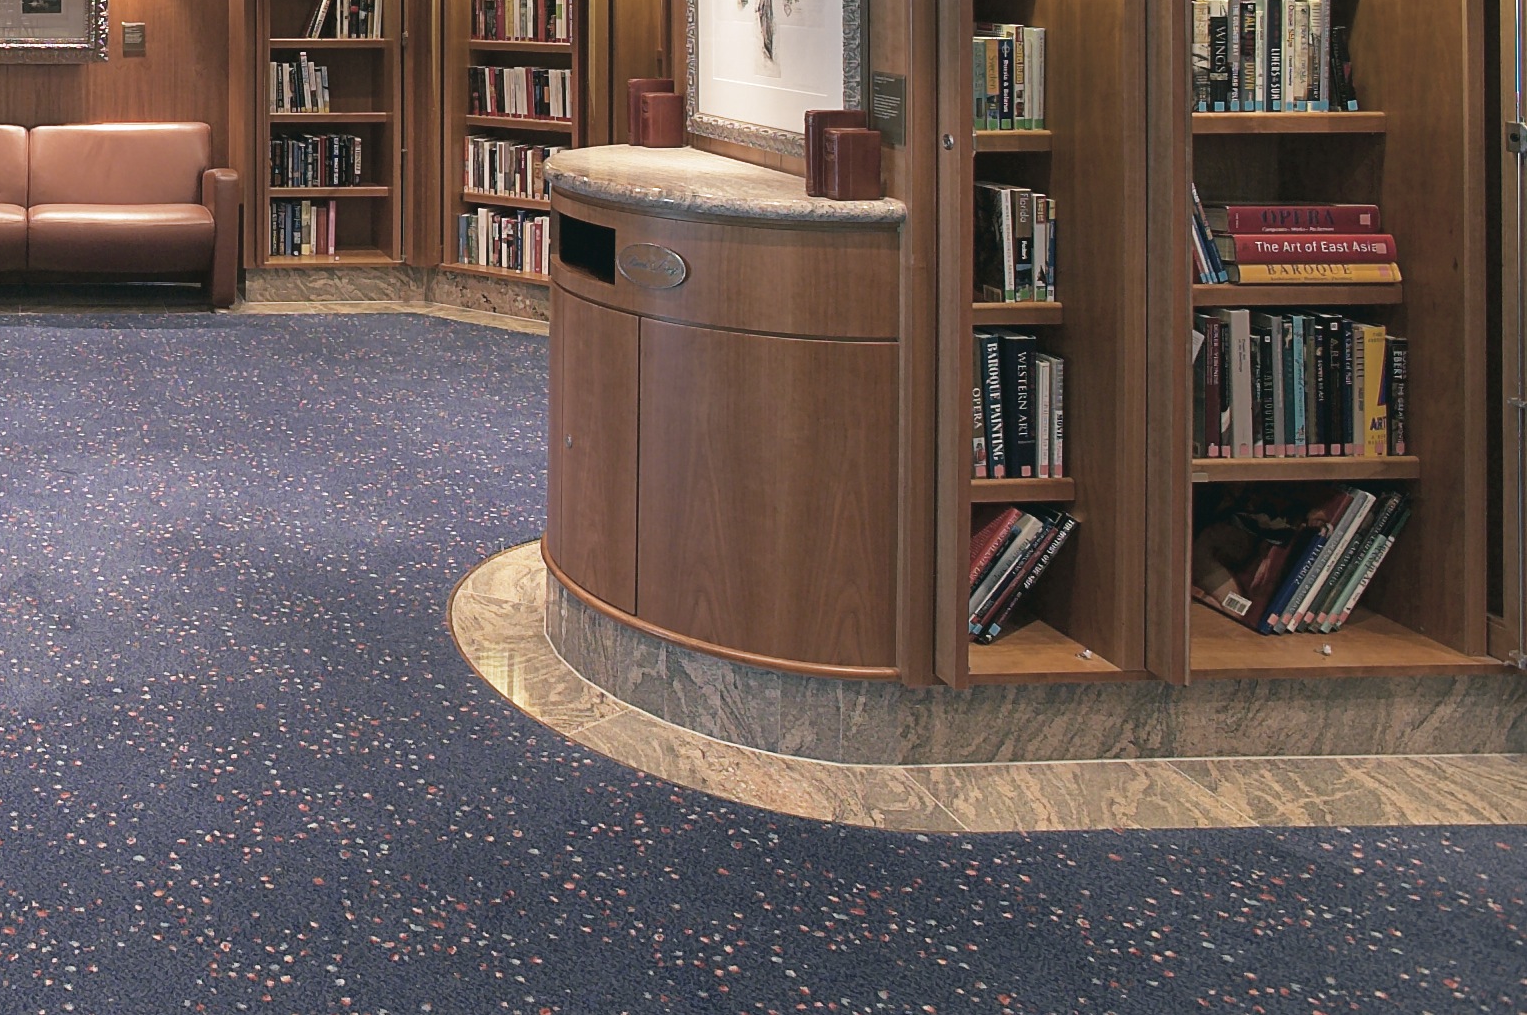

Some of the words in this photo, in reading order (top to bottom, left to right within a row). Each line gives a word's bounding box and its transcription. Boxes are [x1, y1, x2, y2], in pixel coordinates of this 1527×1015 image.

[1215, 26, 1226, 73] WINGS
[1270, 48, 1281, 76] LINERS
[988, 55, 998, 90] Sweden
[1244, 62, 1255, 90] DOWN
[1270, 83, 1281, 100] SUN
[1019, 193, 1029, 223] Florida
[1260, 208, 1336, 225] OPERA
[1255, 241, 1279, 253] The
[1282, 241, 1302, 253] Art
[1305, 241, 1317, 253] of
[1321, 241, 1349, 253] East
[1352, 241, 1377, 253] Asia
[1267, 264, 1353, 276] BAROQUE
[986, 342, 1001, 400] BAROQUE
[1393, 350, 1403, 379] EBERT
[1018, 351, 1028, 410] WESTERN
[972, 387, 983, 430] OPERA
[990, 403, 1004, 461] PAINTING
[1018, 414, 1028, 437] ART
